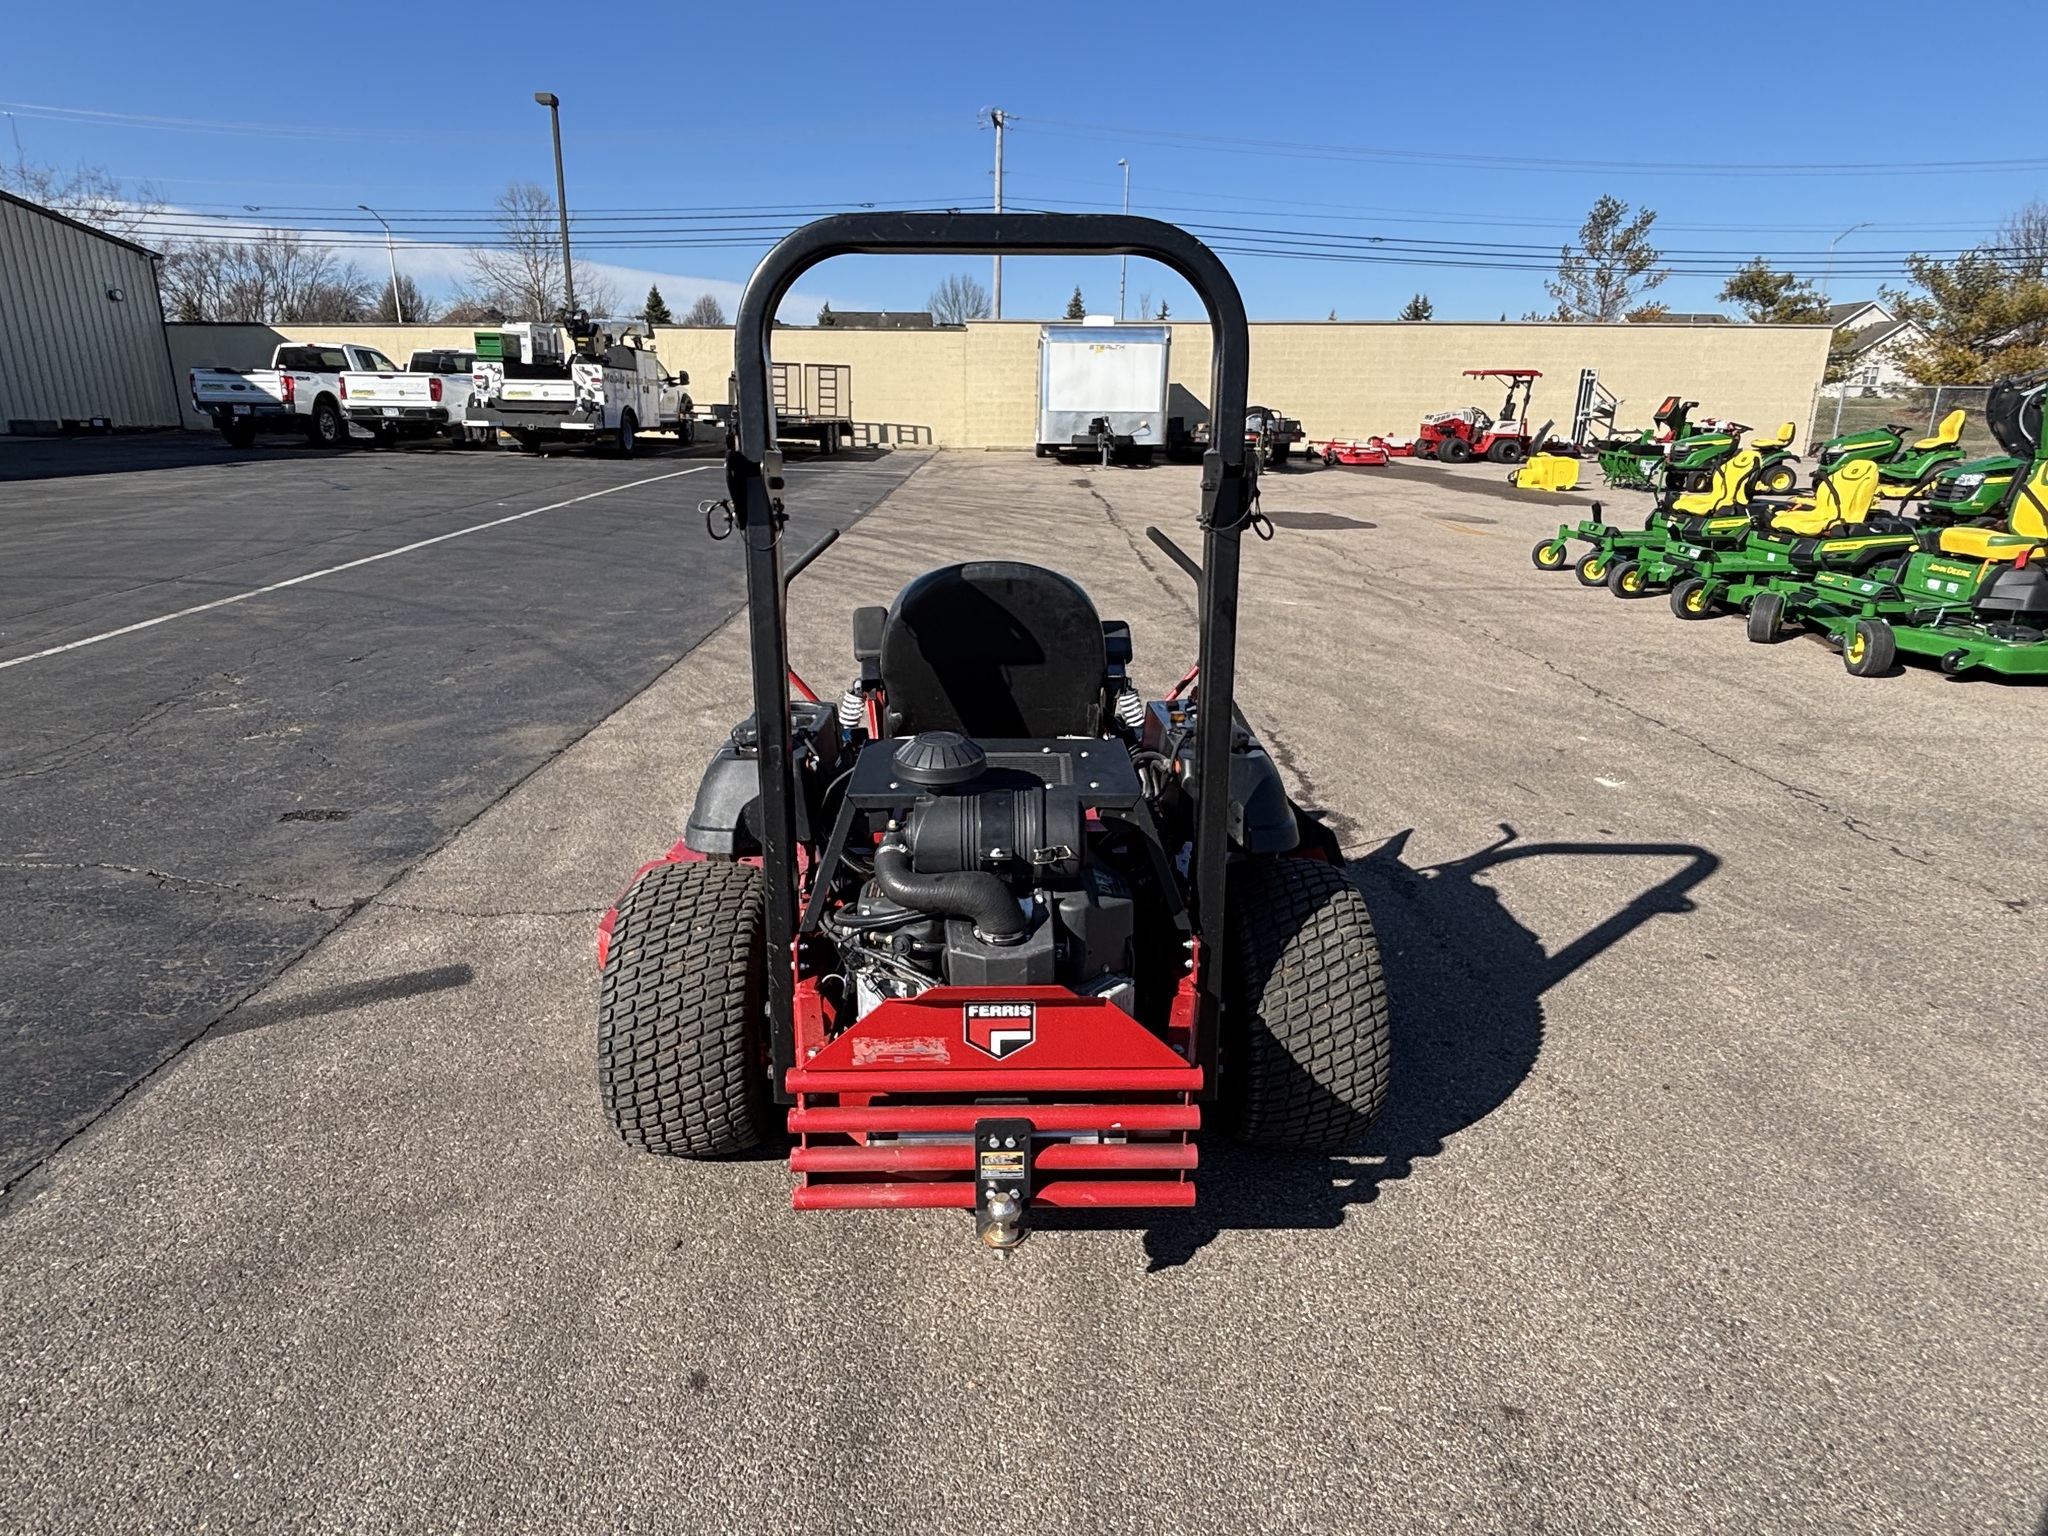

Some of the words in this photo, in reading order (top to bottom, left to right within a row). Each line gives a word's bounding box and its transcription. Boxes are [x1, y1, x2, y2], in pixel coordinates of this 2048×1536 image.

[603, 372, 625, 385] Mobile
[1927, 563, 1948, 574] JOHN
[1947, 566, 1972, 578] DEERE
[968, 1004, 1032, 1017] FERRIS
